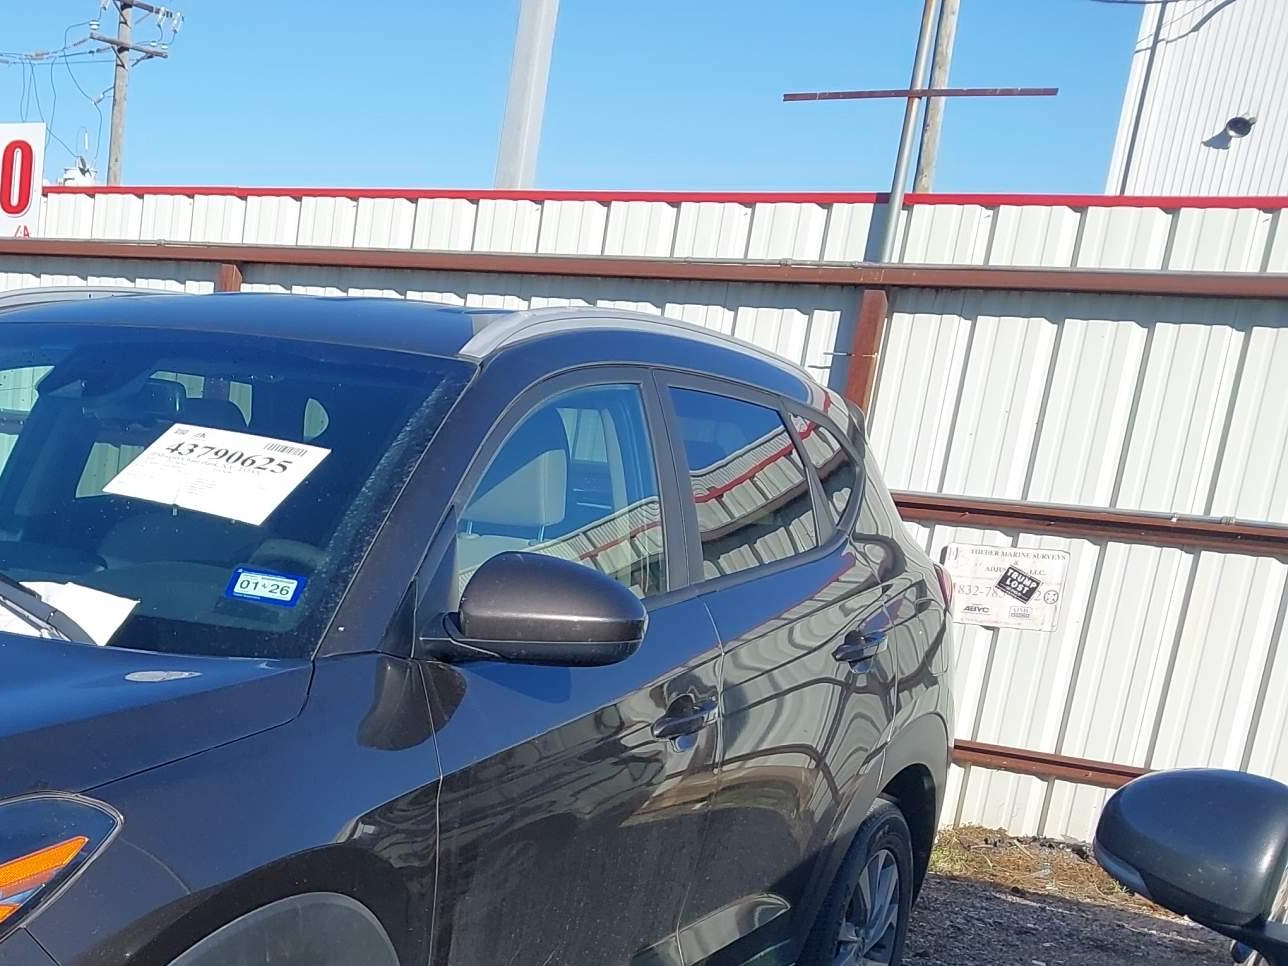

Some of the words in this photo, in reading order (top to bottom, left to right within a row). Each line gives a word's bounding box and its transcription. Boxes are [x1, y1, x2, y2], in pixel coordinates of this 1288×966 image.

[166, 441, 293, 474] 43790625
[239, 579, 259, 591] 01
[268, 583, 291, 596] 26
[1006, 577, 1030, 594] LOST
[1007, 569, 1038, 588] TRUMP
